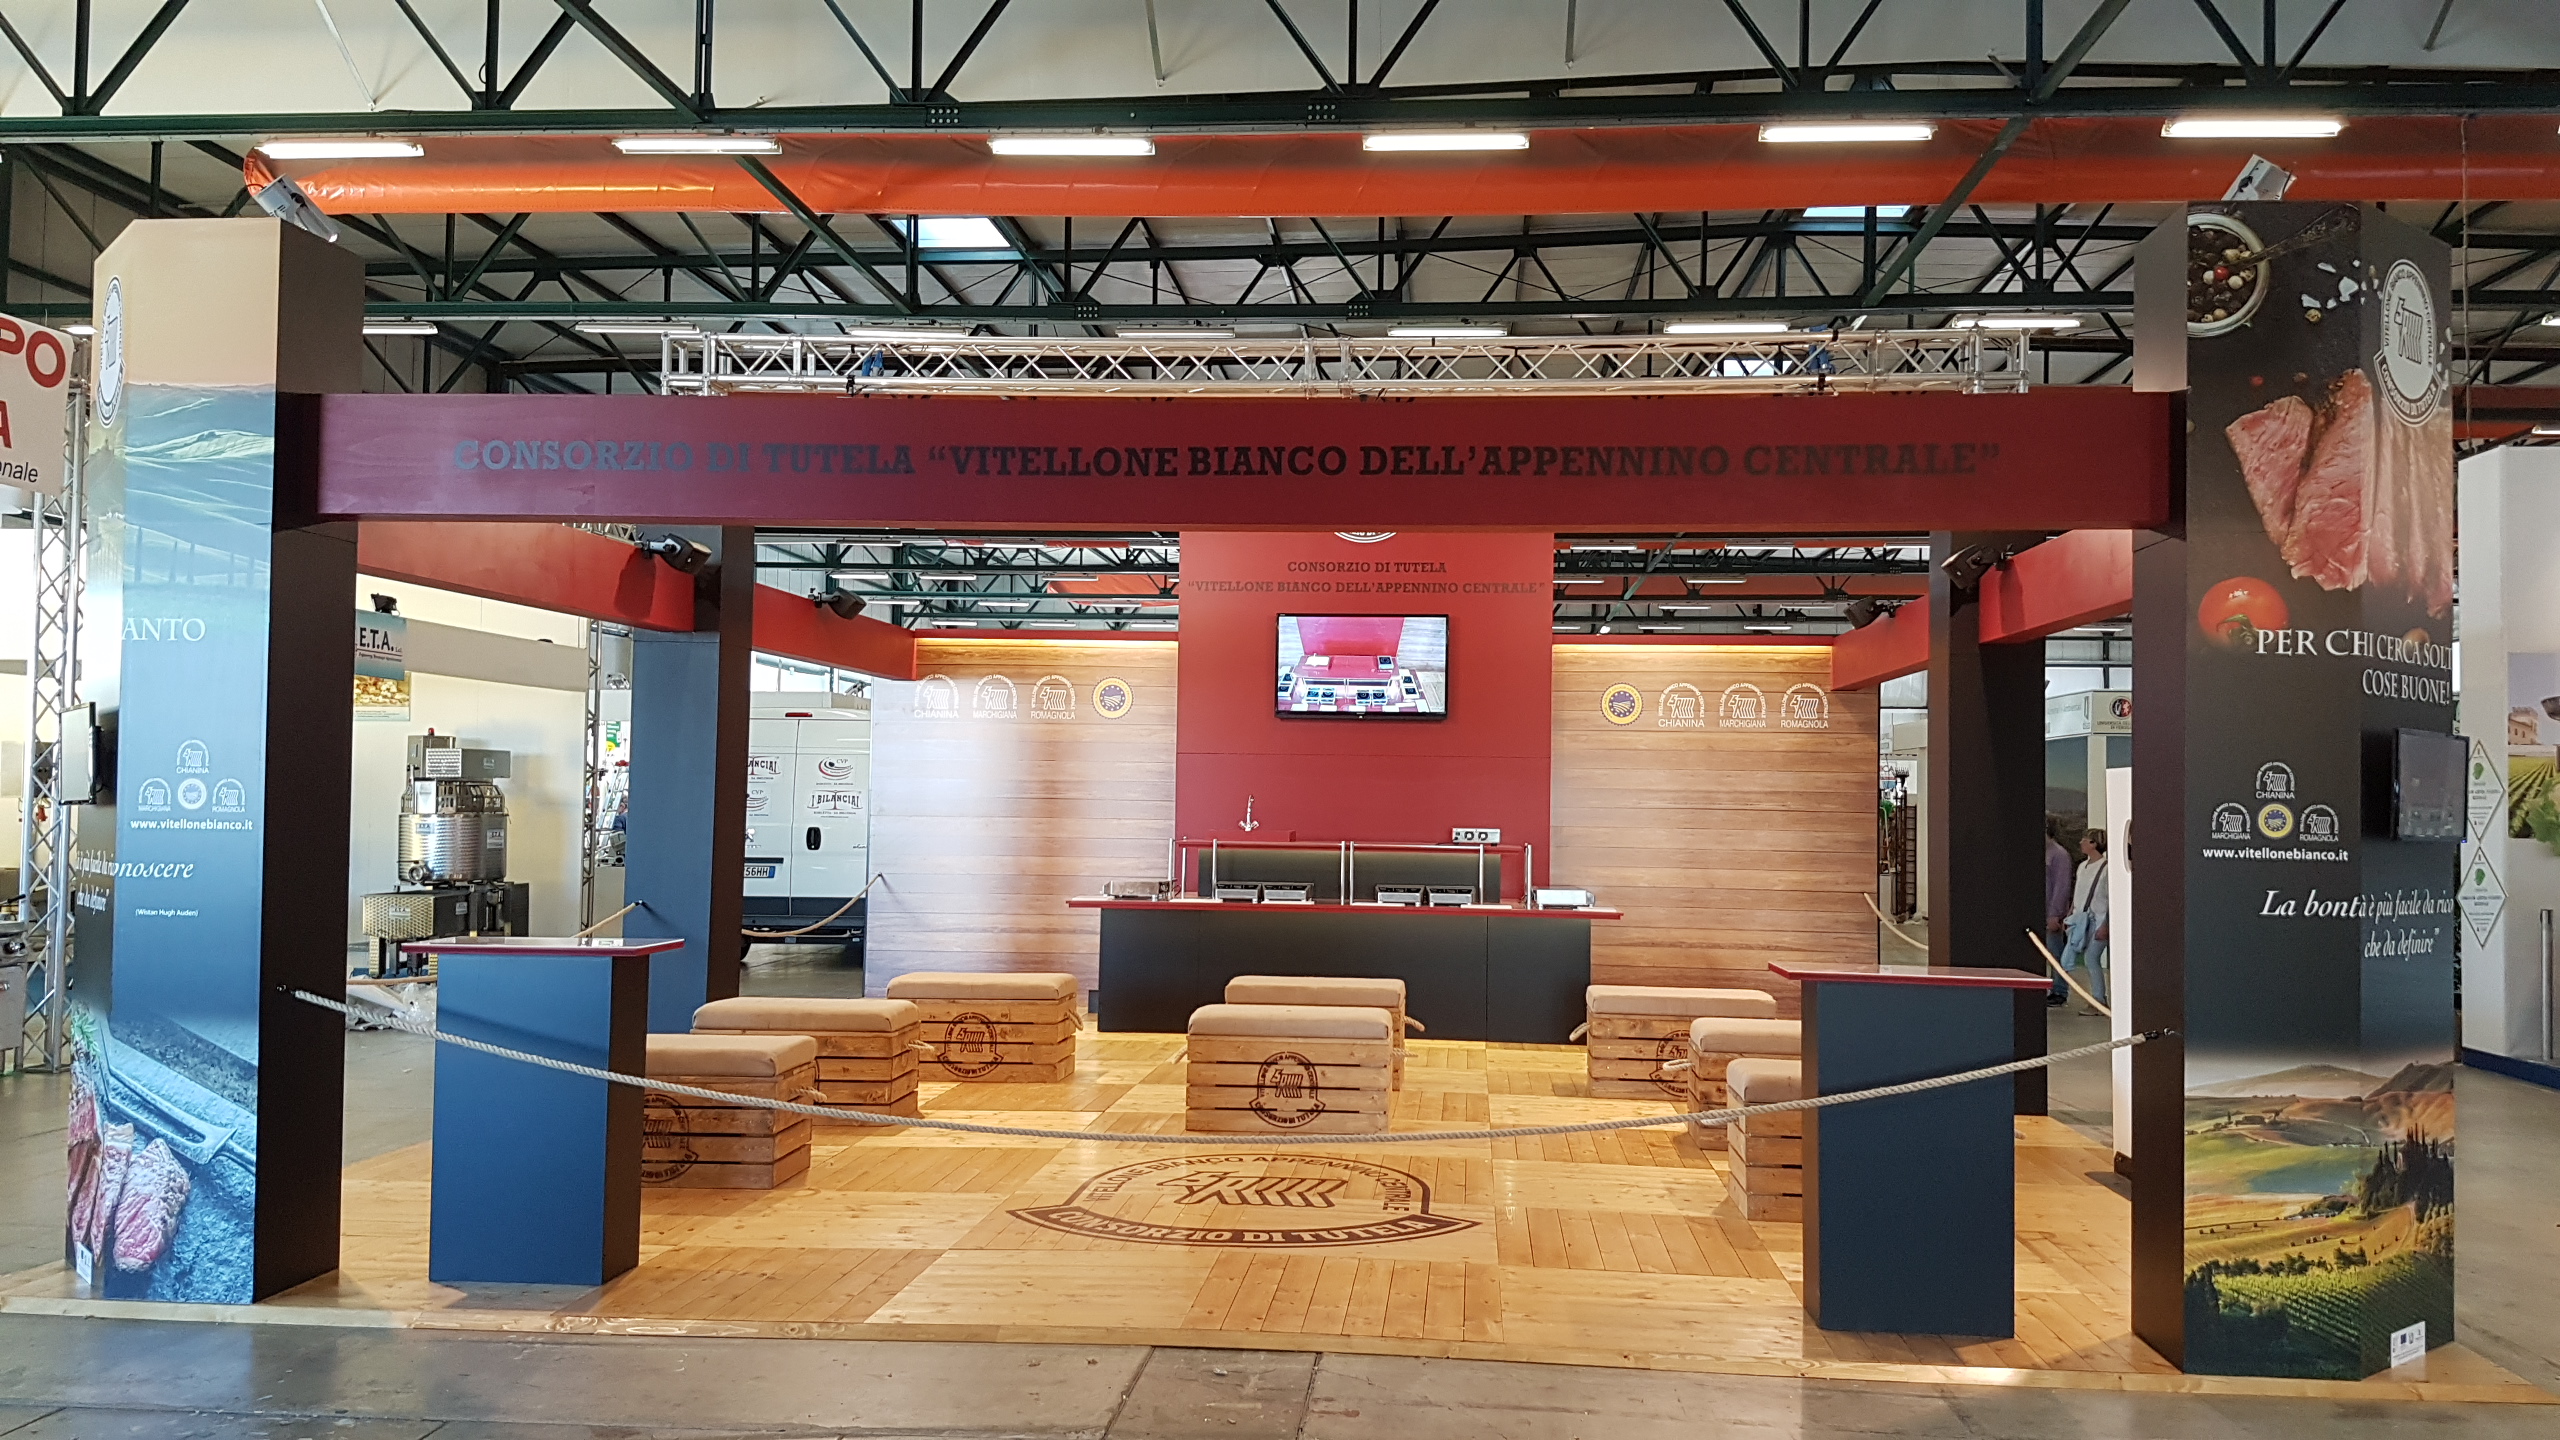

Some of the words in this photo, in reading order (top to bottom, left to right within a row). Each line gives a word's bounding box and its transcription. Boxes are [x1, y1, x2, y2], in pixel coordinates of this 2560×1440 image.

[452, 439, 693, 472] CONSORZIO
[707, 442, 751, 473] DI
[761, 443, 915, 475] TUTELA
[1188, 445, 1347, 476] BIANCO
[0, 461, 38, 483] nale
[1287, 561, 1371, 573] CONSORZIO
[1374, 562, 1391, 573] DI
[1394, 562, 1447, 573] TUTELA
[1277, 581, 1332, 593] BIANCO
[2255, 629, 2318, 656] PER
[2325, 629, 2374, 658] CHI
[2377, 634, 2421, 665] CERCA
[2362, 668, 2399, 698] COSE
[2401, 674, 2450, 705] BUONE!
[914, 709, 959, 718] CHIANINA
[972, 710, 1017, 719] MARCHIGIANA
[1030, 711, 1075, 720] ROMAGNOLA
[1658, 719, 1705, 728] CHIANINA
[1719, 719, 1766, 728] MARCHIGIANA
[1780, 720, 1829, 729] ROMAGNOLA
[2256, 791, 2295, 799] CHIANINA
[130, 819, 253, 830] www.vitellonebianco.it
[2212, 832, 2251, 840] MARCHIGIANA
[2300, 833, 2338, 842] ROMAGNOLA
[2202, 847, 2348, 861] www.vitellonebianco.it
[743, 867, 769, 876] 56HH
[2260, 890, 2296, 916] La
[2303, 889, 2366, 917] bontà
[2368, 894, 2375, 916] è
[2375, 891, 2394, 924] più
[2393, 889, 2421, 922] facile
[2422, 889, 2434, 915] da
[159, 909, 176, 917] Hugh
[176, 909, 199, 917] Auden)
[2364, 931, 2381, 958] che
[2382, 930, 2396, 956] da
[1145, 1156, 1244, 1171] BIANCO
[1251, 1156, 1389, 1178] APPENNINO
[1047, 1210, 1234, 1241] CONSORZIO
[1241, 1229, 1284, 1242] DI
[1290, 1218, 1436, 1242] TUTELA
